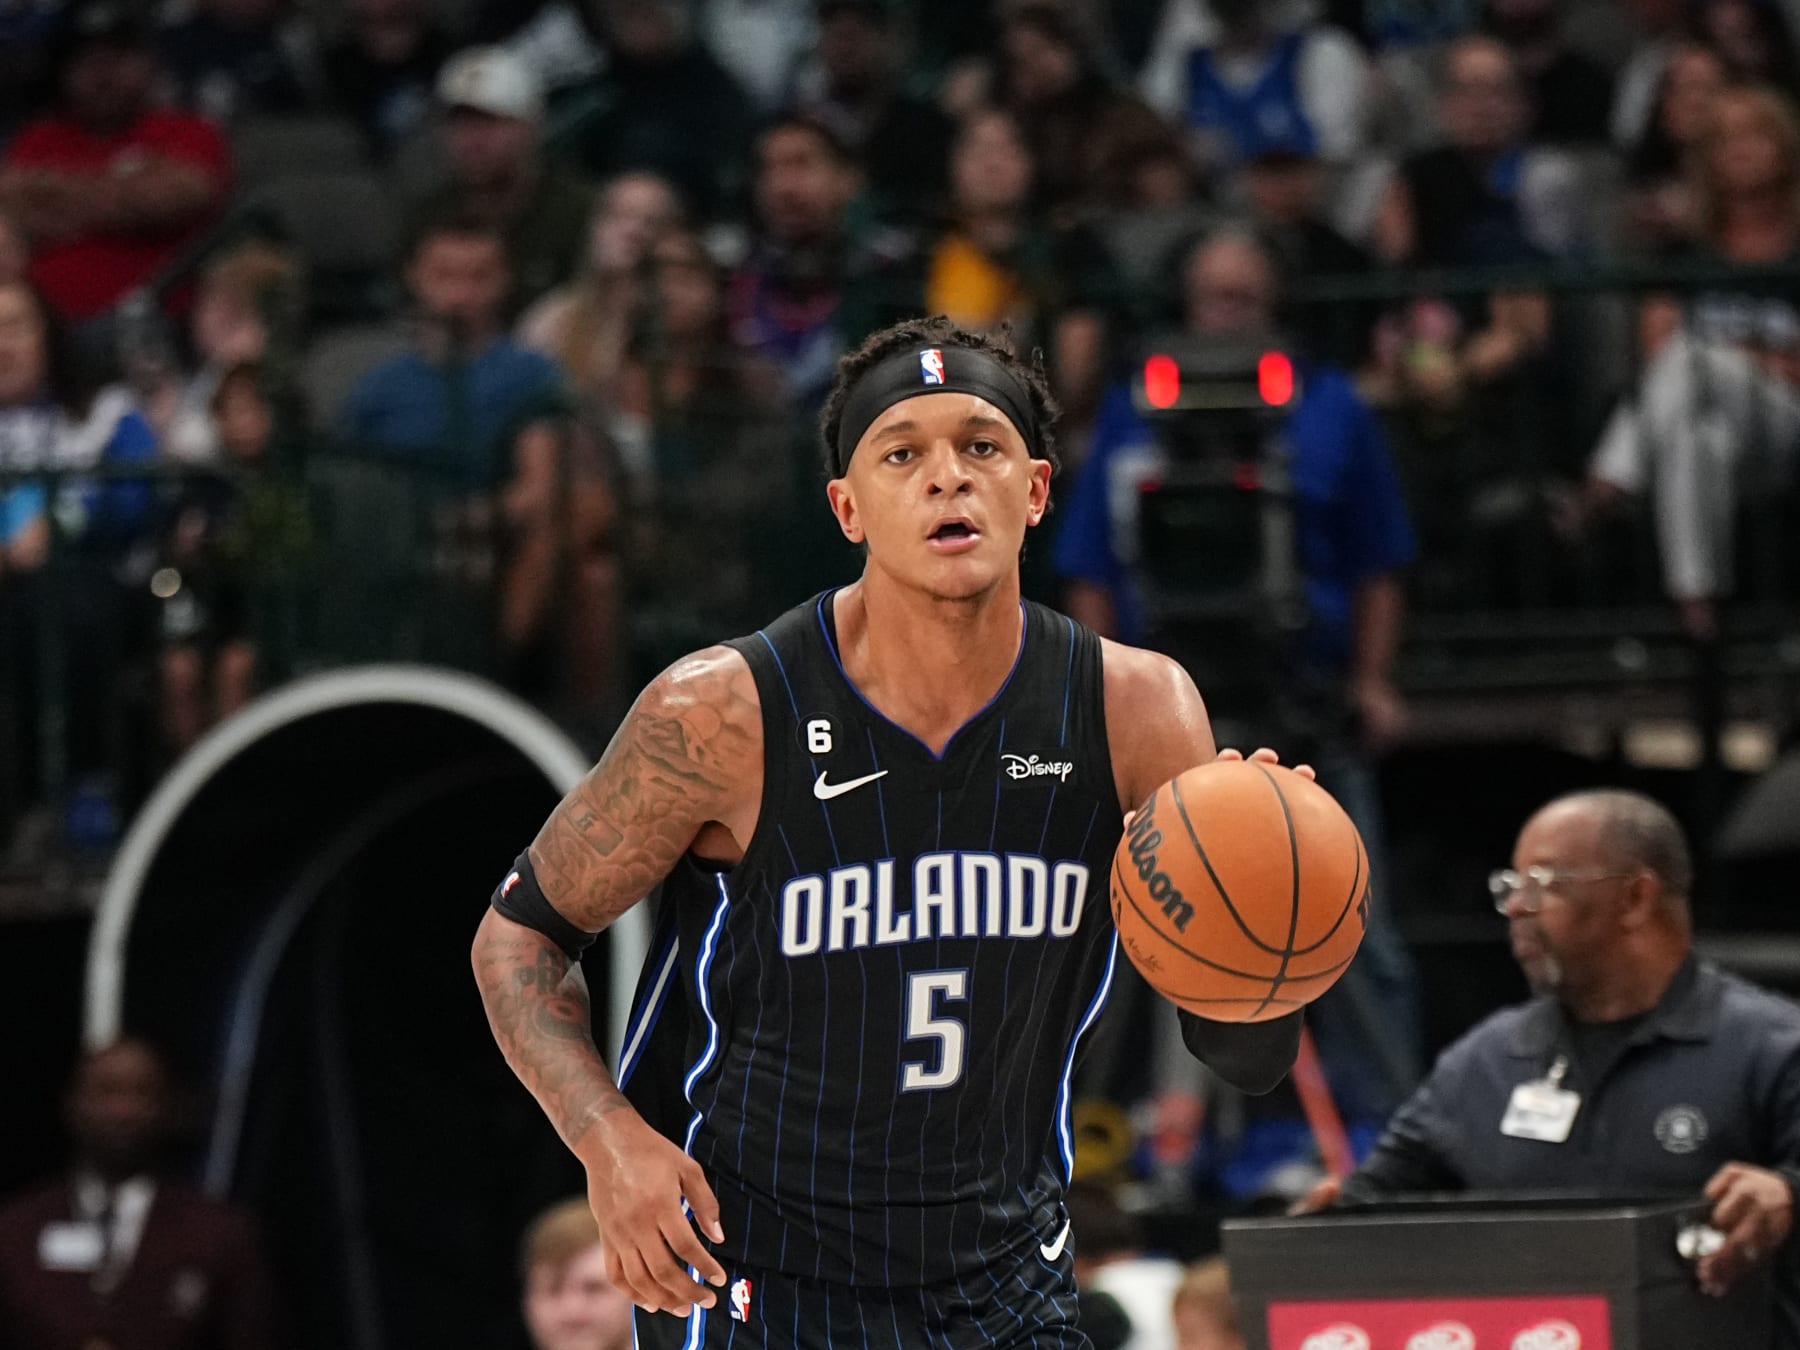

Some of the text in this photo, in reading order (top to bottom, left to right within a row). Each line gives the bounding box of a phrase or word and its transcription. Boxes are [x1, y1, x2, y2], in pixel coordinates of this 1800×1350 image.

[807, 719, 832, 754] 6
[780, 850, 1090, 957] ORLANDO
[902, 967, 969, 1092] 5
